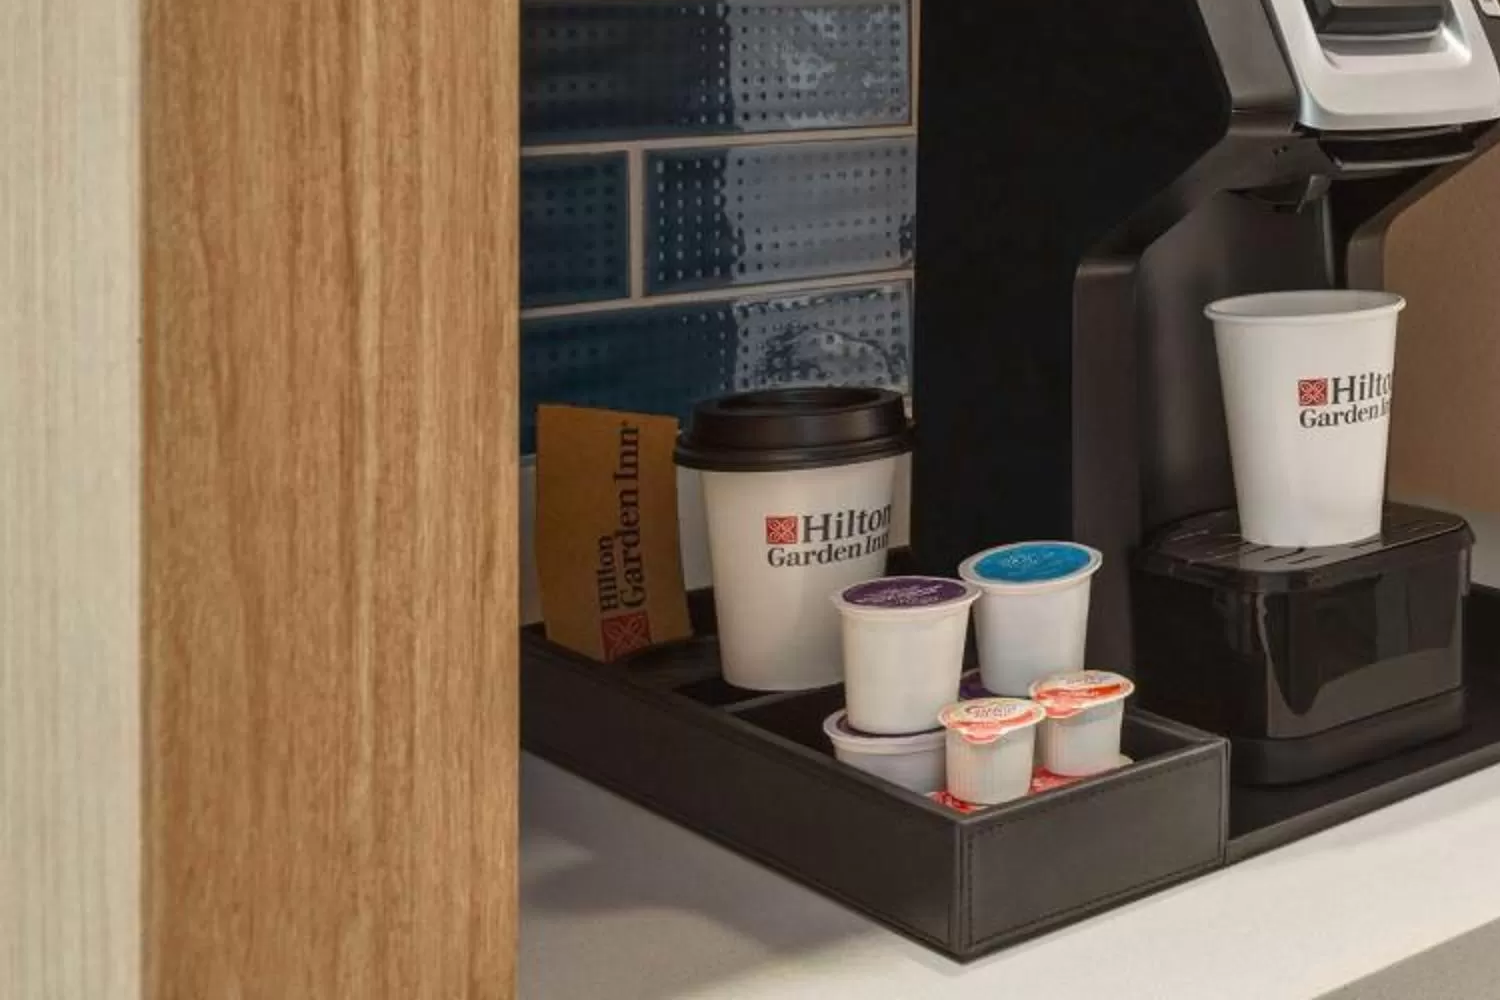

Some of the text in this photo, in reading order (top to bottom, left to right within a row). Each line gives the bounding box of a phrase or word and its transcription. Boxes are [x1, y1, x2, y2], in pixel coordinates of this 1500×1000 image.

[1331, 371, 1392, 405] Hilto
[1299, 404, 1379, 429] Garden
[613, 426, 646, 609] Garden Inn
[802, 504, 892, 543] Hilton
[767, 543, 862, 568] Garden
[596, 535, 619, 613] Hilton
